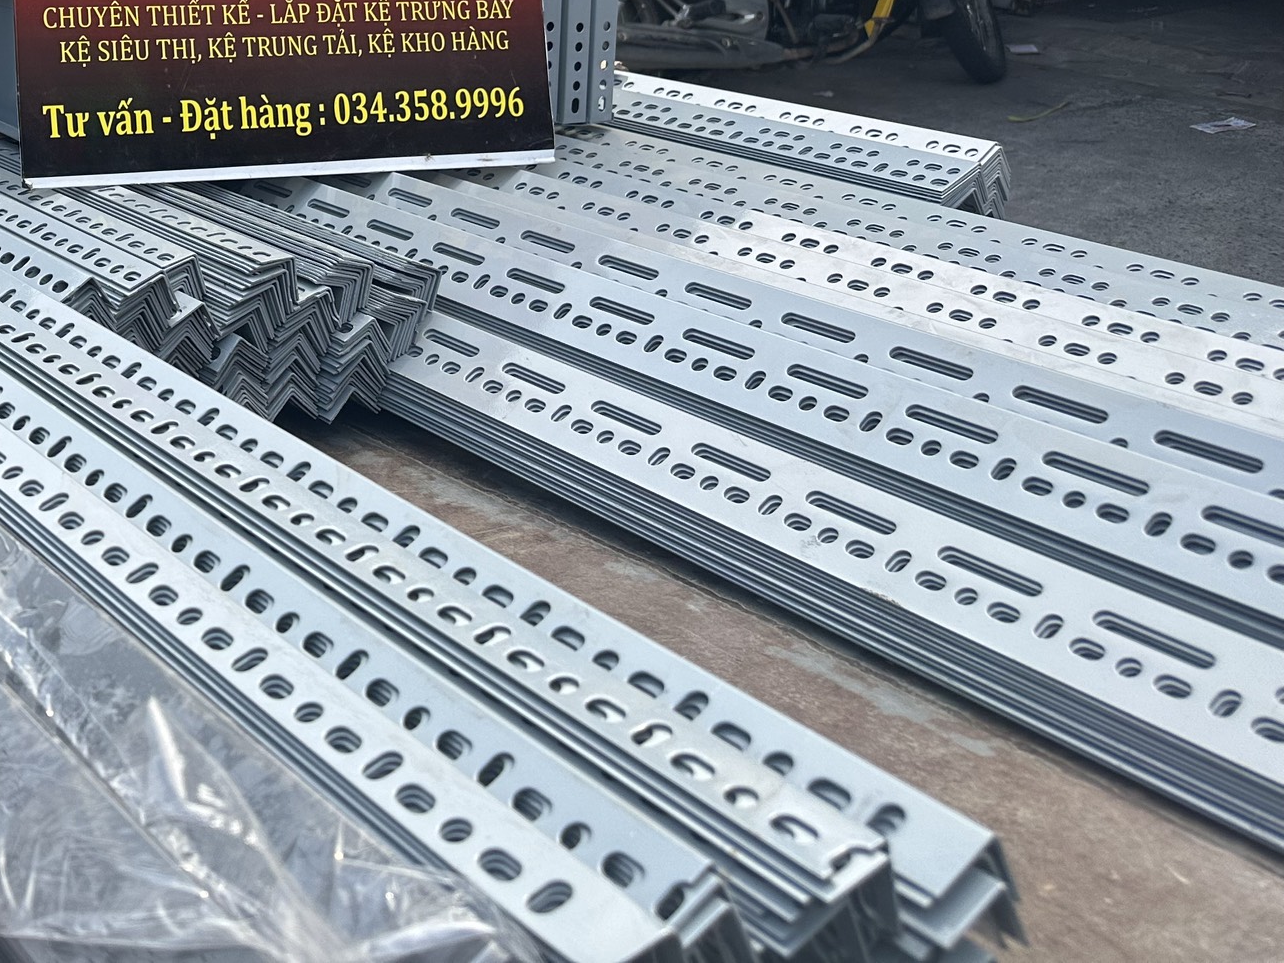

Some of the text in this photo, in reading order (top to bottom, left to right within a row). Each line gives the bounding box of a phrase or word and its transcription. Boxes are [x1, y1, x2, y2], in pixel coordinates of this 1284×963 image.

[43, 0, 141, 30] CHUYÊN
[59, 25, 510, 67] KỆ SIÊU THỊ, KỆ TRUNG TẢI, KỆ KHO HÀNG
[42, 101, 91, 138] Tư
[97, 97, 154, 136] vấn
[180, 97, 233, 140] Đặt
[239, 94, 312, 137] hàng
[333, 85, 525, 127] 034.358.9996
